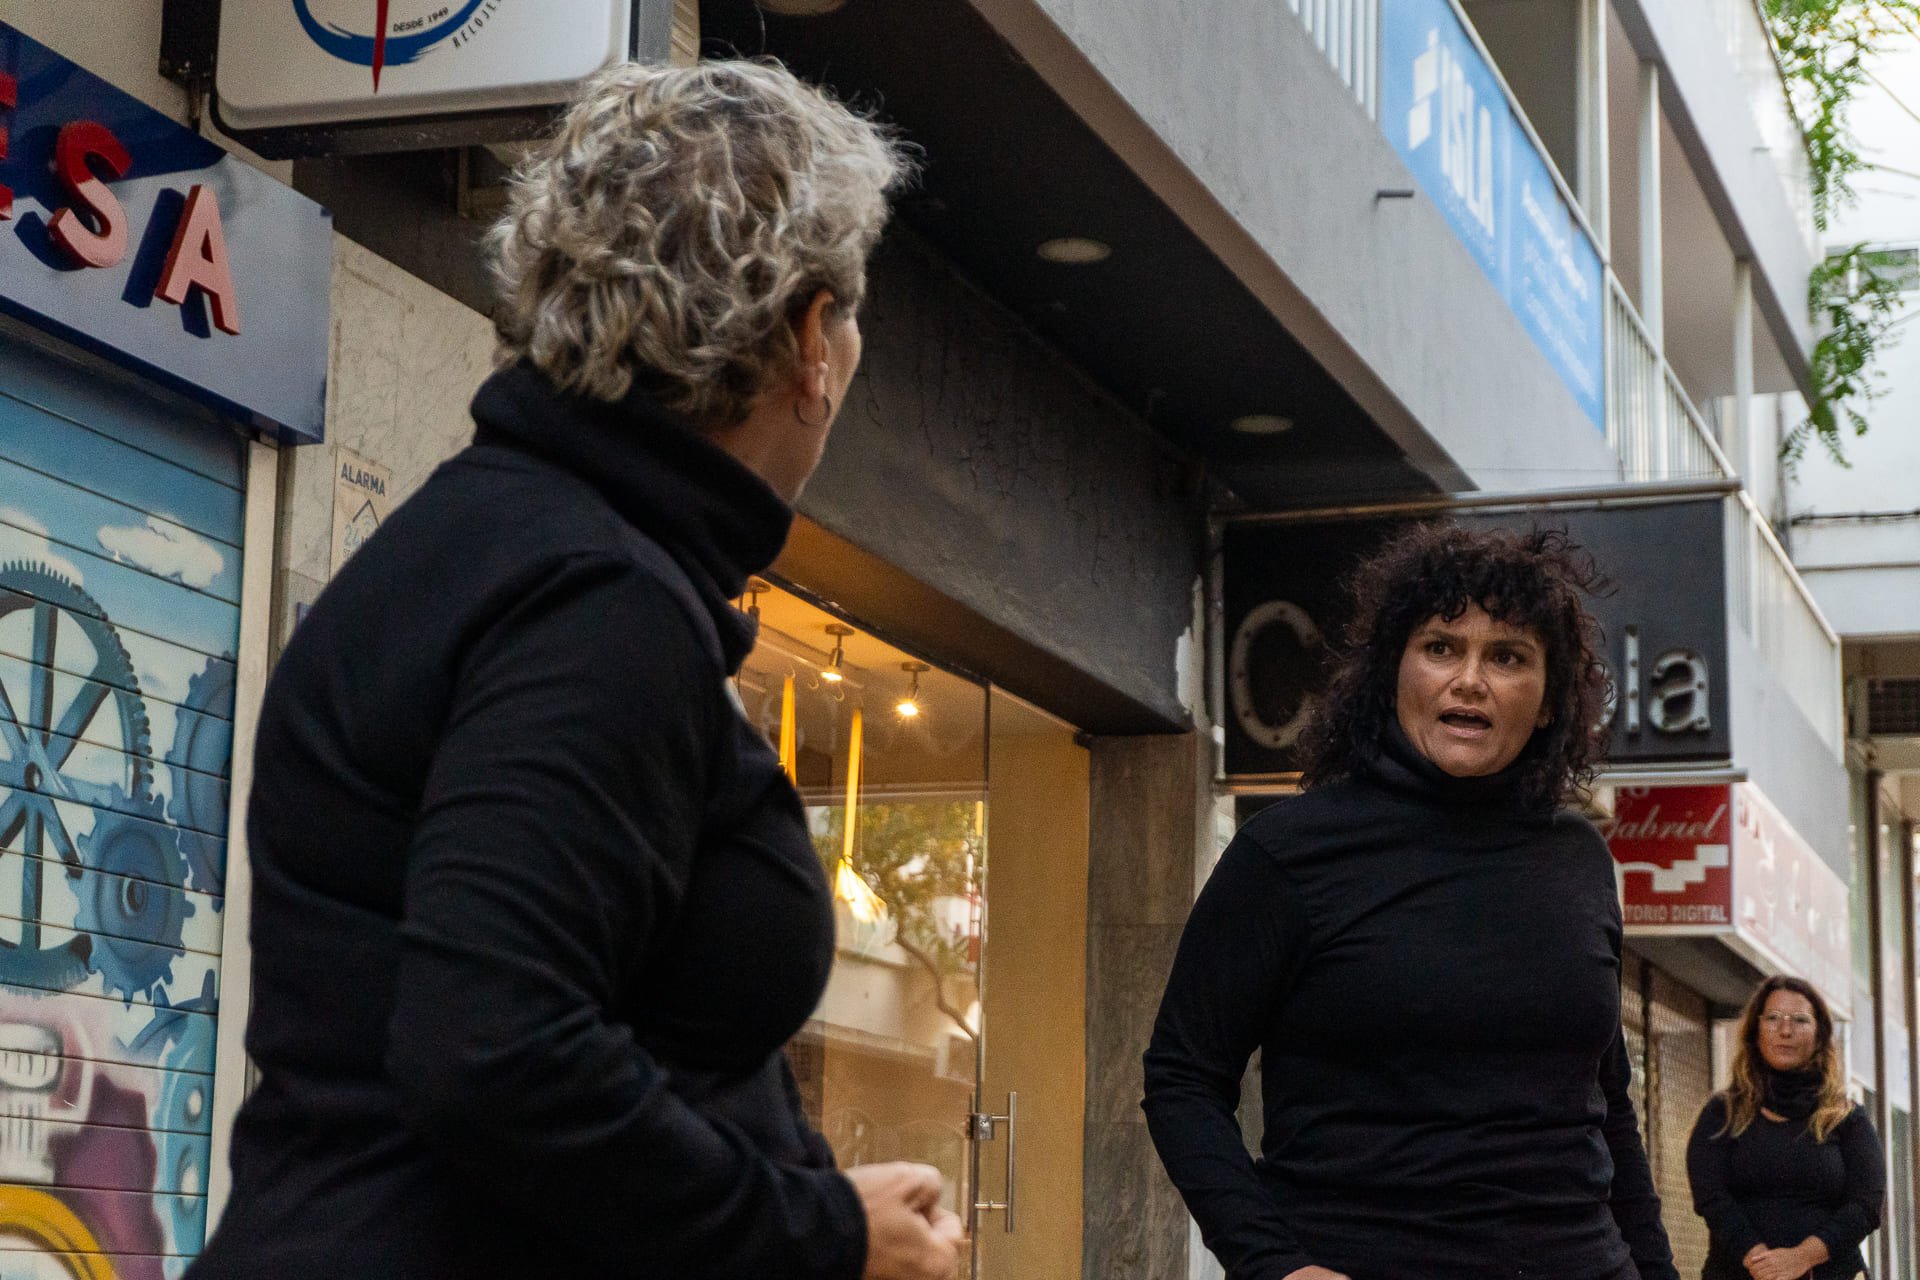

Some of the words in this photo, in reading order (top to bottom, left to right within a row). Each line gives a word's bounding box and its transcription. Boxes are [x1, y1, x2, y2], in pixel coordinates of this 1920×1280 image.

[393, 17, 424, 32] DESDE
[427, 6, 449, 22] 1949
[452, 0, 502, 48] RELOJE
[341, 462, 386, 497] ALARMA
[1672, 903, 1729, 923] DIGITAL
